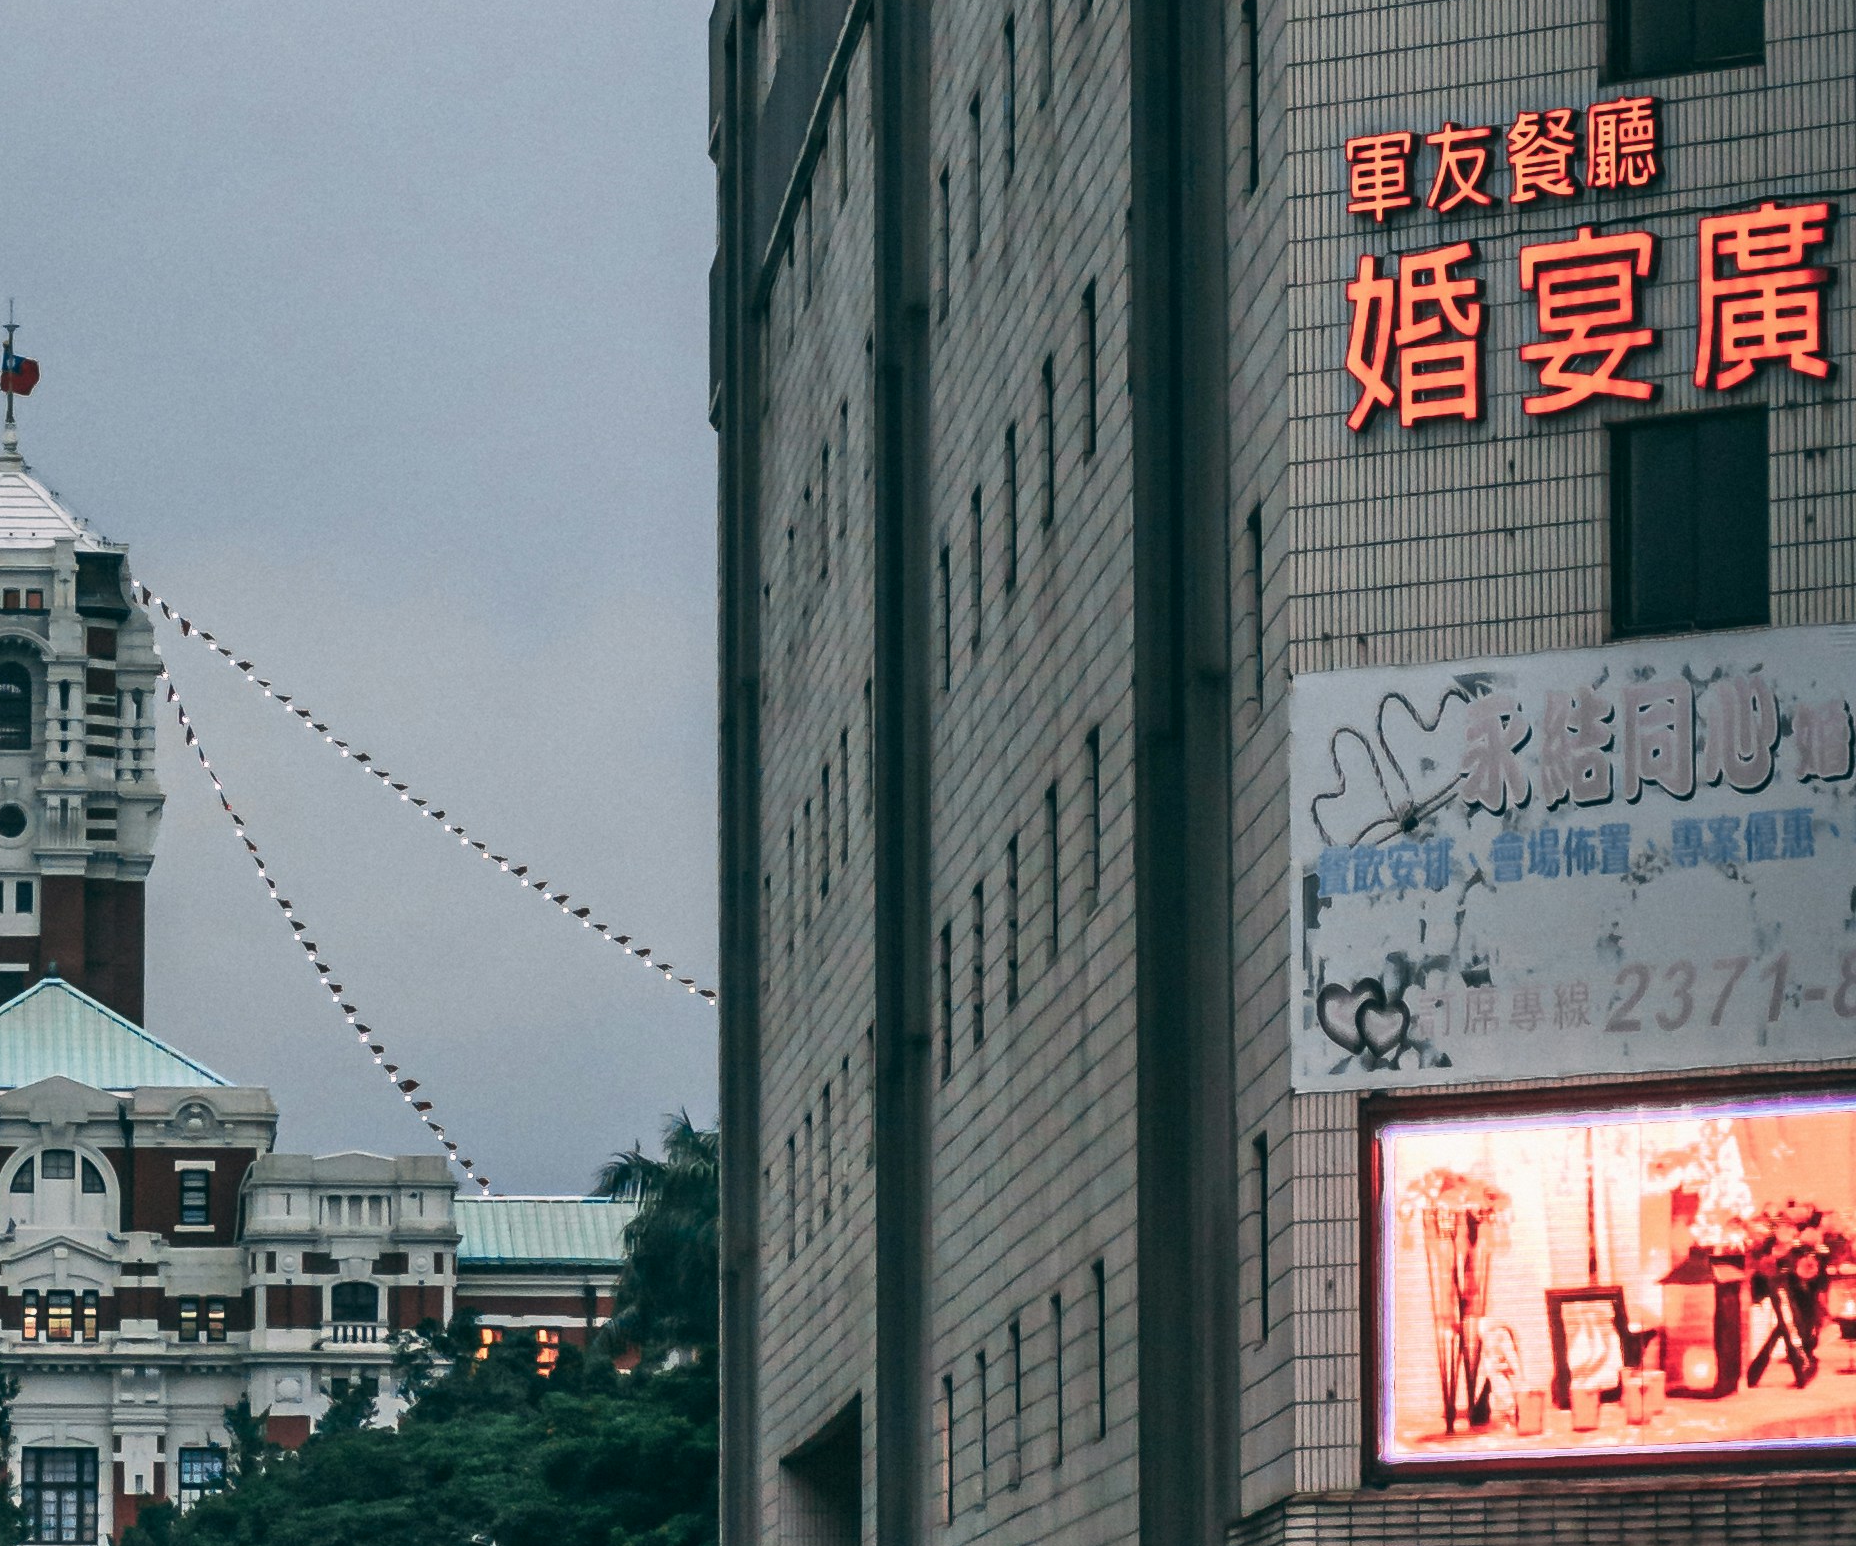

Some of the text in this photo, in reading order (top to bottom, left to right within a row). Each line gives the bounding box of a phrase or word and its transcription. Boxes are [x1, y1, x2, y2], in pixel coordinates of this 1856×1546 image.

[1346, 97, 1657, 223] 軍友餐廳
[1346, 202, 1834, 432] 婚宴廣
